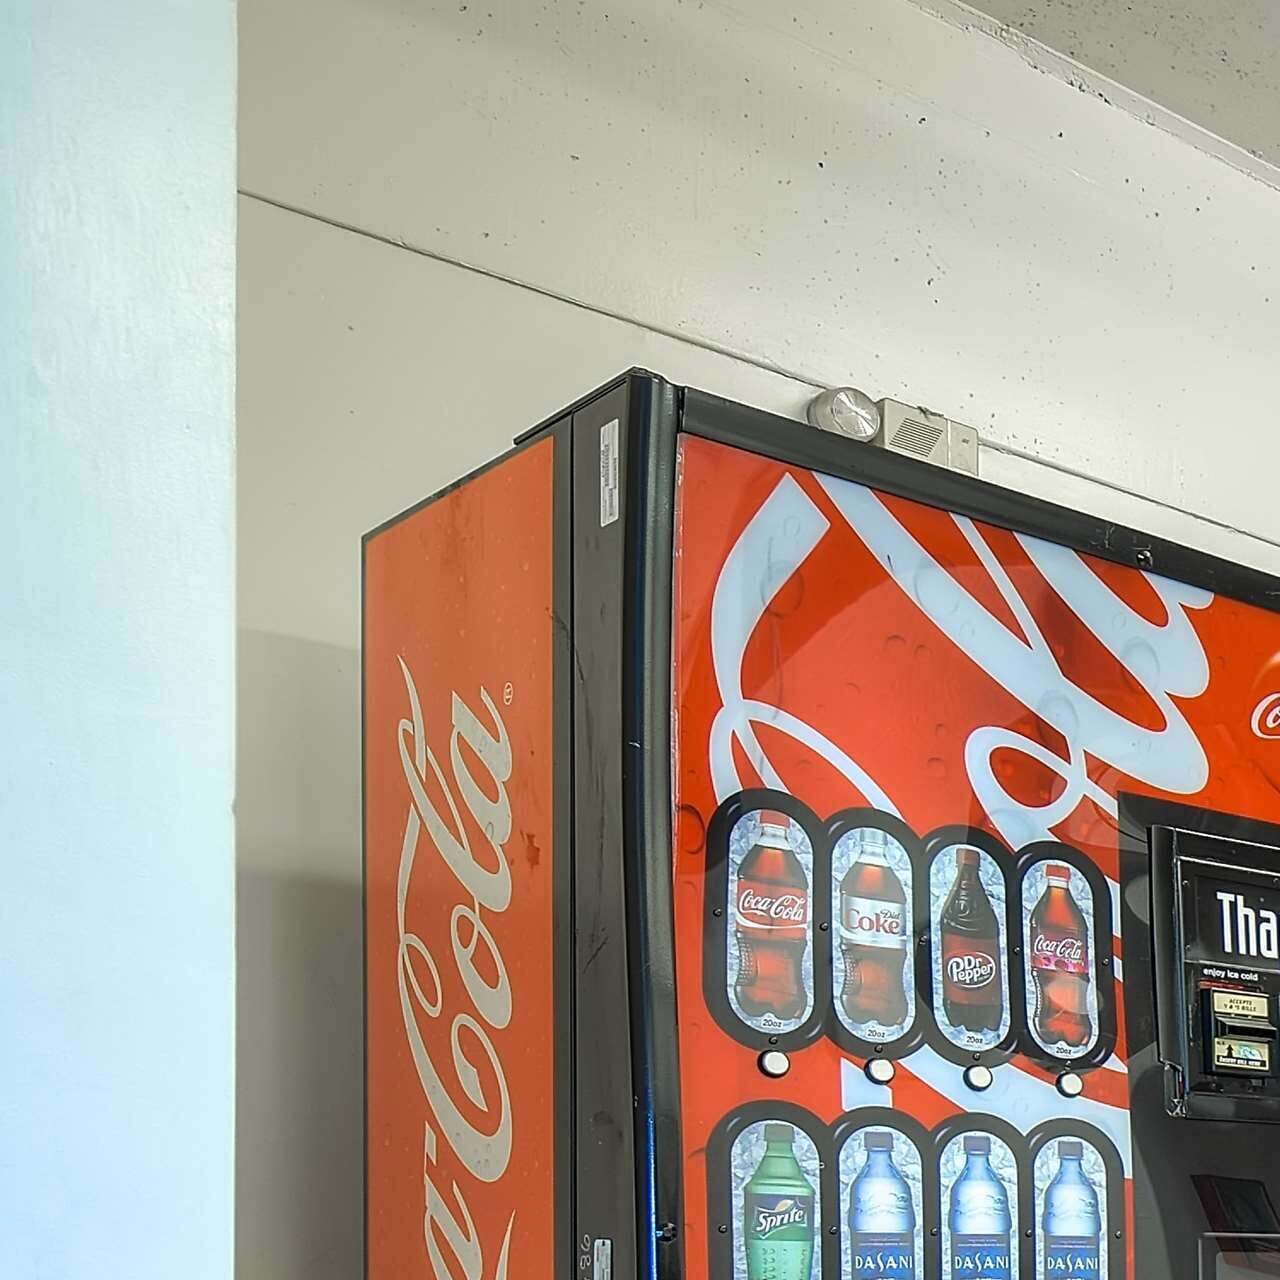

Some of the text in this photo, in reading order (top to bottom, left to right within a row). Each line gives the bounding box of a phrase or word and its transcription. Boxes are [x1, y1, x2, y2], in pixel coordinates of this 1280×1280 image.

[739, 889, 807, 922] Coca-Cola
[848, 908, 900, 935] Coke
[1034, 935, 1082, 960] Coca-Cola
[951, 956, 993, 984] Pepper
[964, 955, 982, 969] Dr
[1203, 968, 1259, 981] enjoy ice cold
[762, 1018, 783, 1028] 20oz
[867, 1029, 886, 1039] 20oz
[966, 1035, 983, 1044] 20oz
[1056, 1046, 1072, 1055] 20oz
[755, 1207, 805, 1233] Sprite
[854, 1252, 913, 1273] DASANI
[954, 1252, 1009, 1273] DASANI
[1047, 1253, 1099, 1273] DASANI
